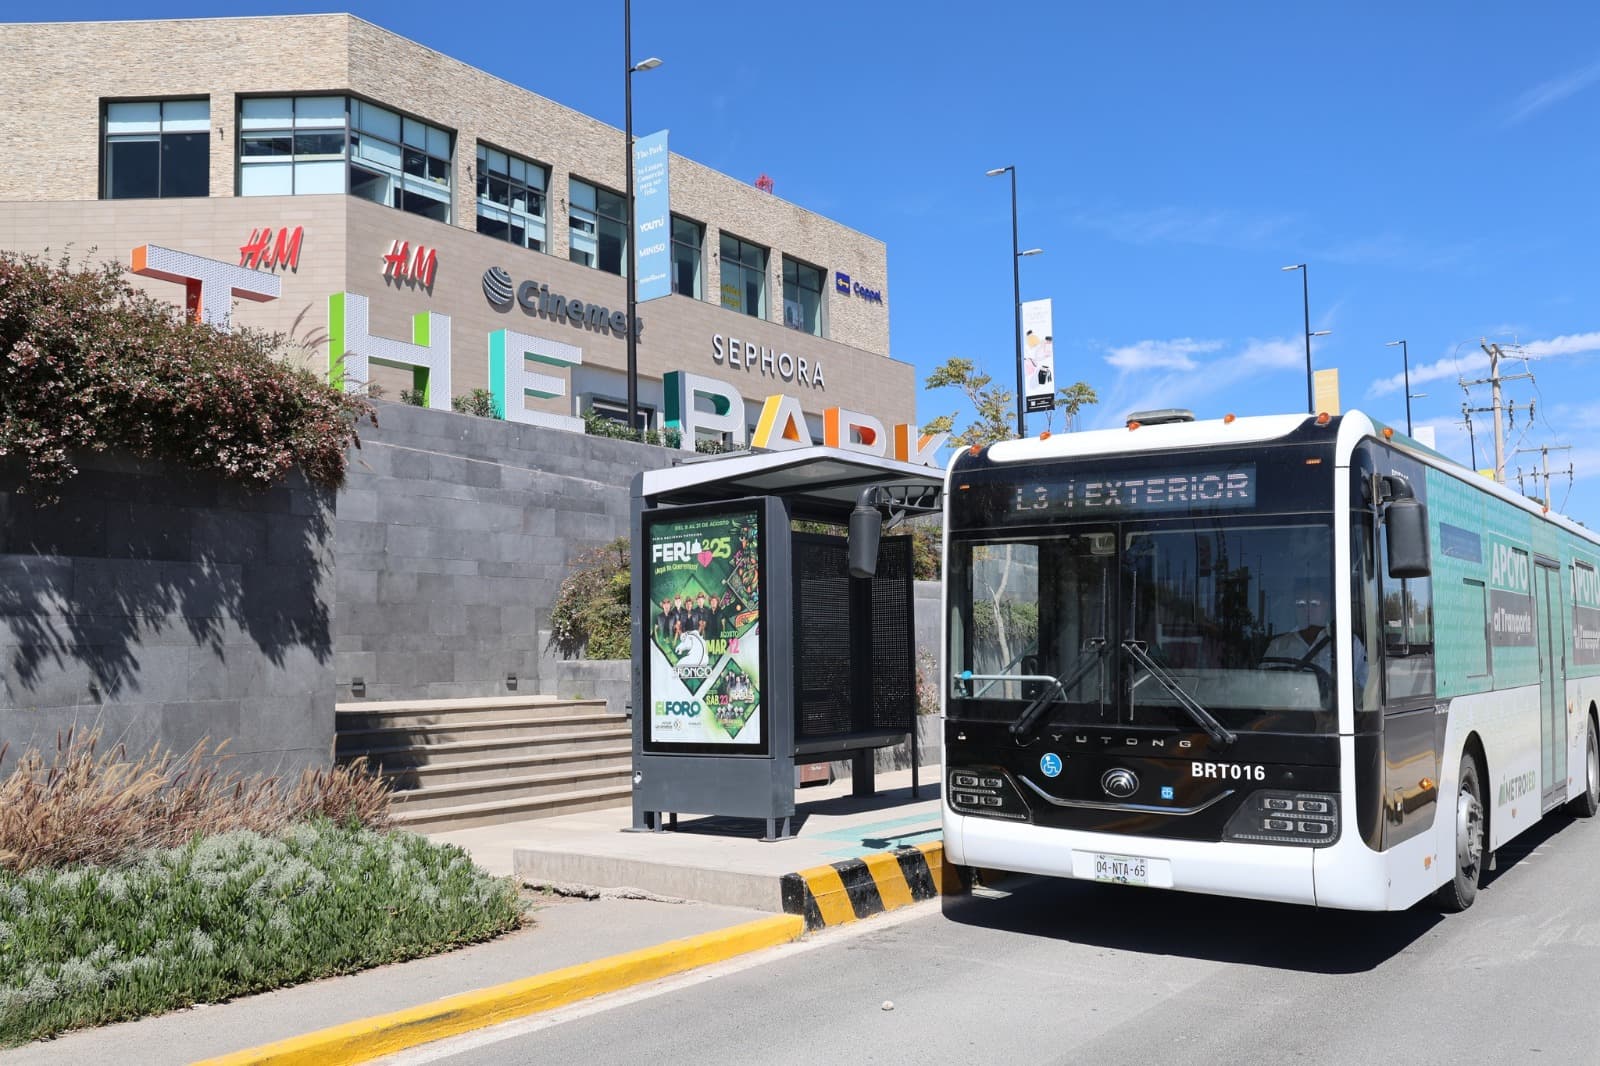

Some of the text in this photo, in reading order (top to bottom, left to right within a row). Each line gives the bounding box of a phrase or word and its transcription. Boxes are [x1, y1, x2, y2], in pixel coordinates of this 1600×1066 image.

[240, 225, 304, 271] H&M
[382, 239, 438, 287] H&M
[713, 334, 825, 388] SEPHORA
[1085, 473, 1248, 506] EXTERIOR
[706, 639, 727, 655] MAR
[1051, 734, 1192, 748] YUTONG
[1191, 761, 1266, 781] BRT016
[1096, 861, 1146, 877] 04-NTA-65
